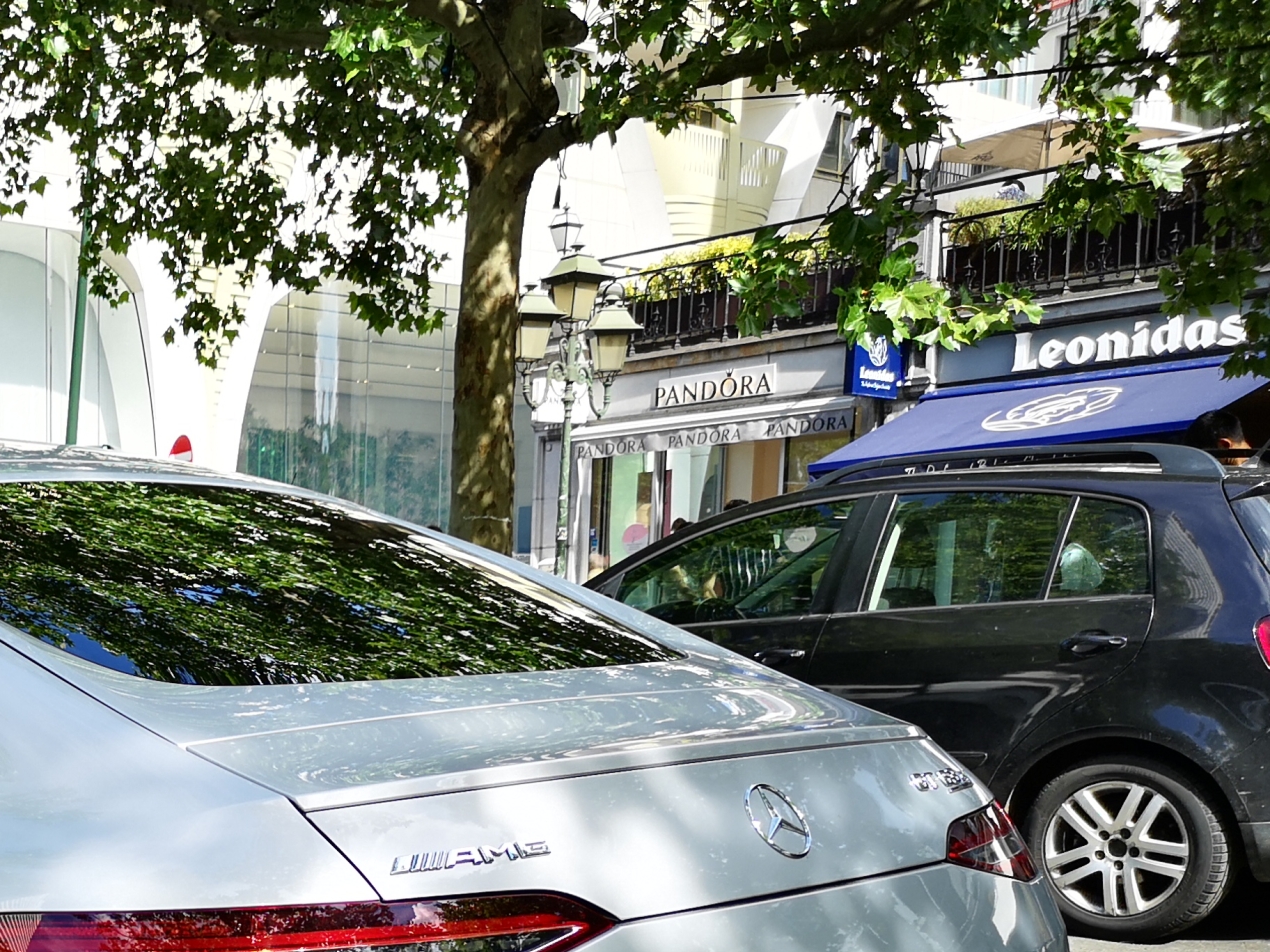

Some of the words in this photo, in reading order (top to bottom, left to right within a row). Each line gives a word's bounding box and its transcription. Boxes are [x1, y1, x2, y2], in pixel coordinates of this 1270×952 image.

[1011, 314, 1247, 372] Leonidas
[655, 371, 771, 407] PANDORA
[765, 414, 847, 437] PANDORA
[577, 437, 645, 459] PANDORA
[668, 428, 741, 449] PANDORA
